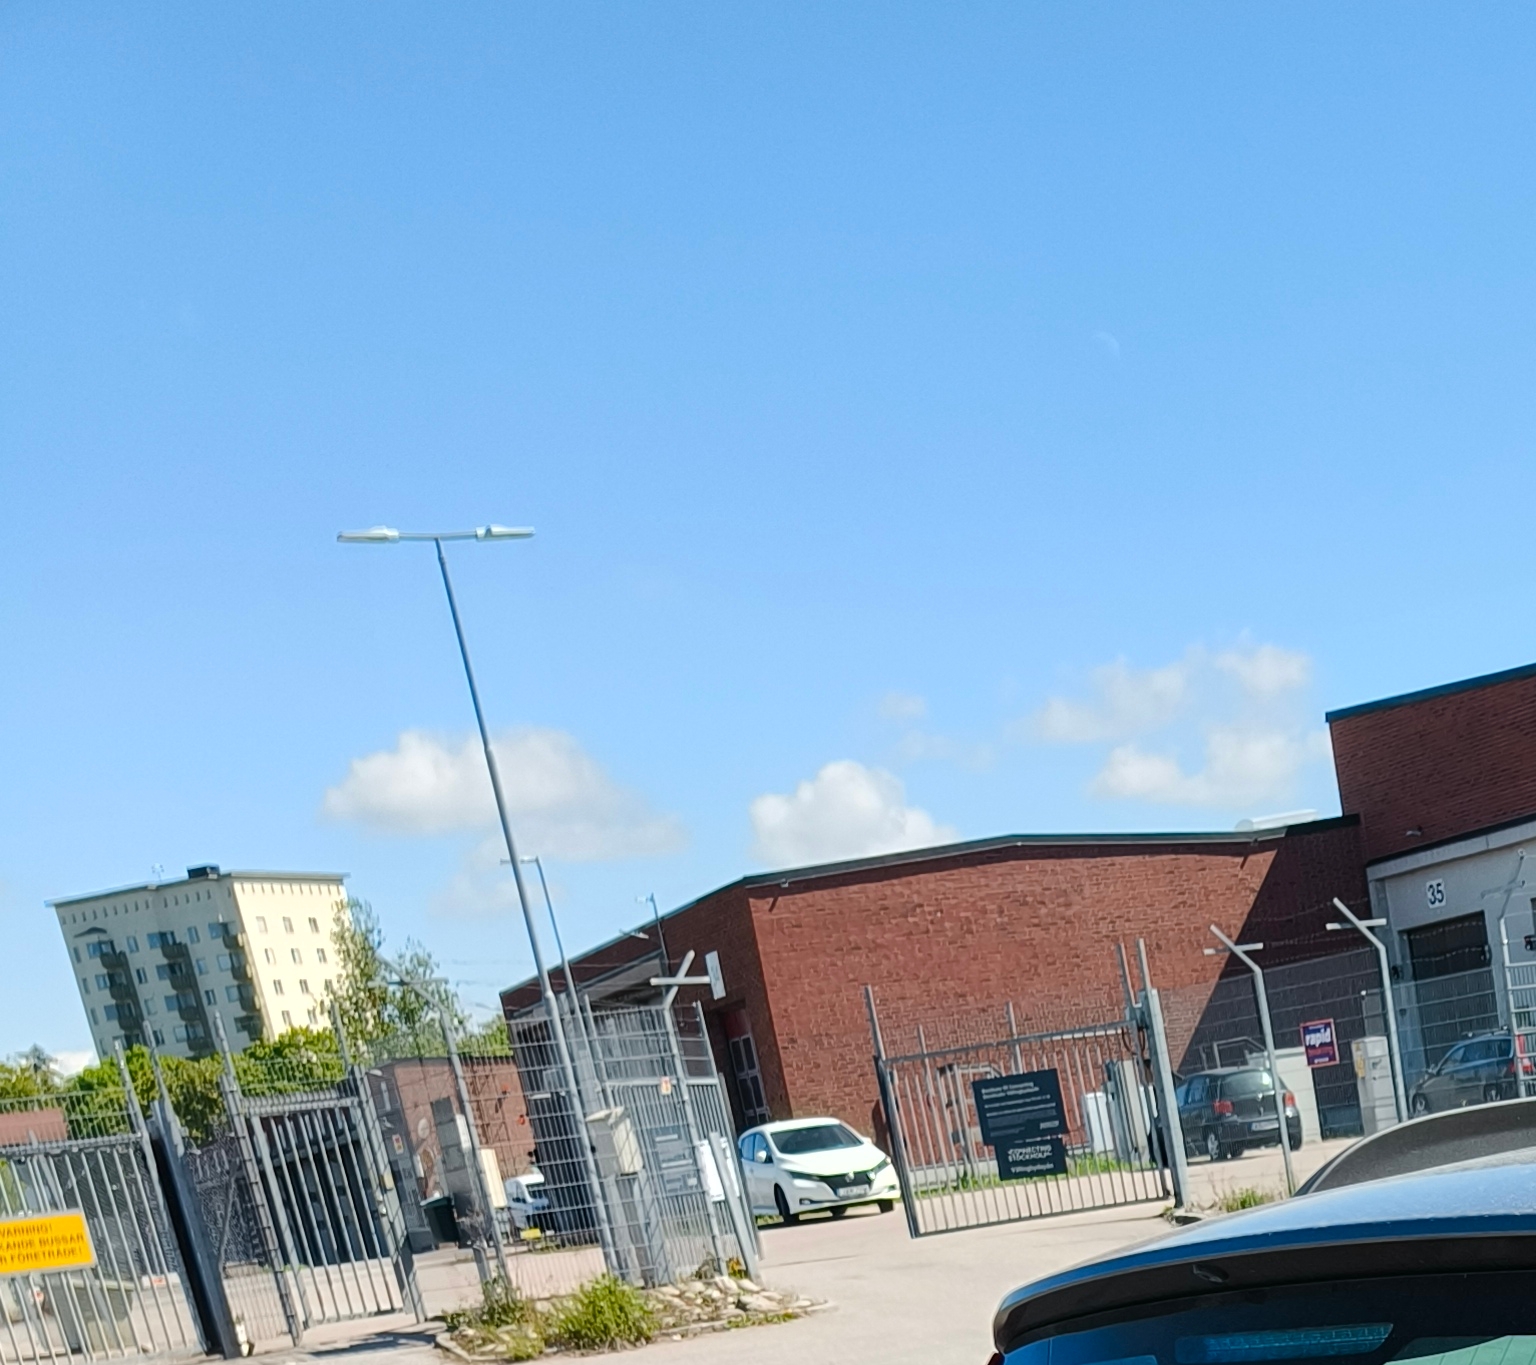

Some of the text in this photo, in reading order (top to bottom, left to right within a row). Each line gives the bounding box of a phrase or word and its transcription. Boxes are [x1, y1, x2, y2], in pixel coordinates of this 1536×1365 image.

[1427, 882, 1445, 906] 35
[1305, 1027, 1331, 1048] rapid
[38, 1232, 84, 1247] BUSSAR
